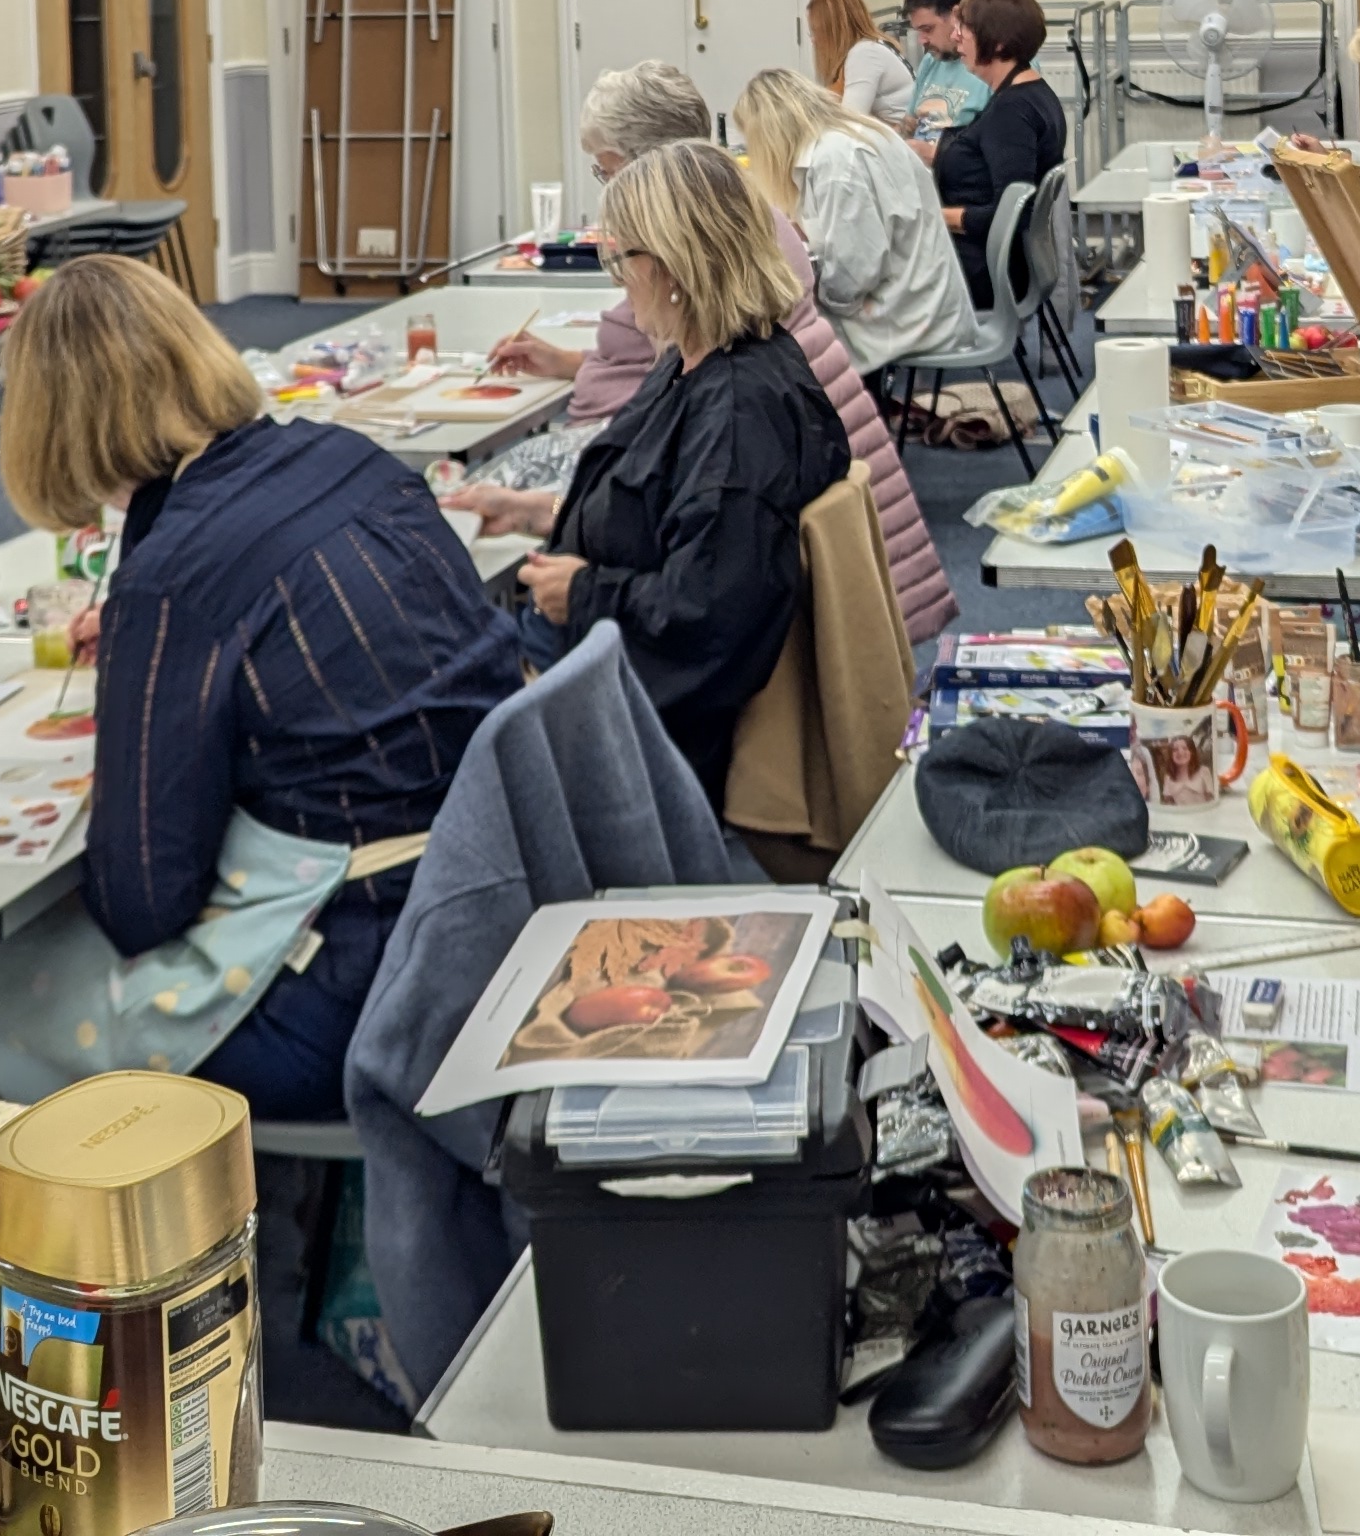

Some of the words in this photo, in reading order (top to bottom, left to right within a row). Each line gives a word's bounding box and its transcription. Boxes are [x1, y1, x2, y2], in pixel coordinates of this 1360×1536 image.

[26, 1316, 53, 1337] Frappé
[28, 1304, 42, 1322] Try
[44, 1314, 56, 1324] an
[57, 1310, 77, 1329] Iced
[1080, 1348, 1130, 1372] Original
[1059, 1368, 1111, 1386] Pickled
[11, 1424, 101, 1478] GOLD
[20, 1459, 88, 1496] BLEND
